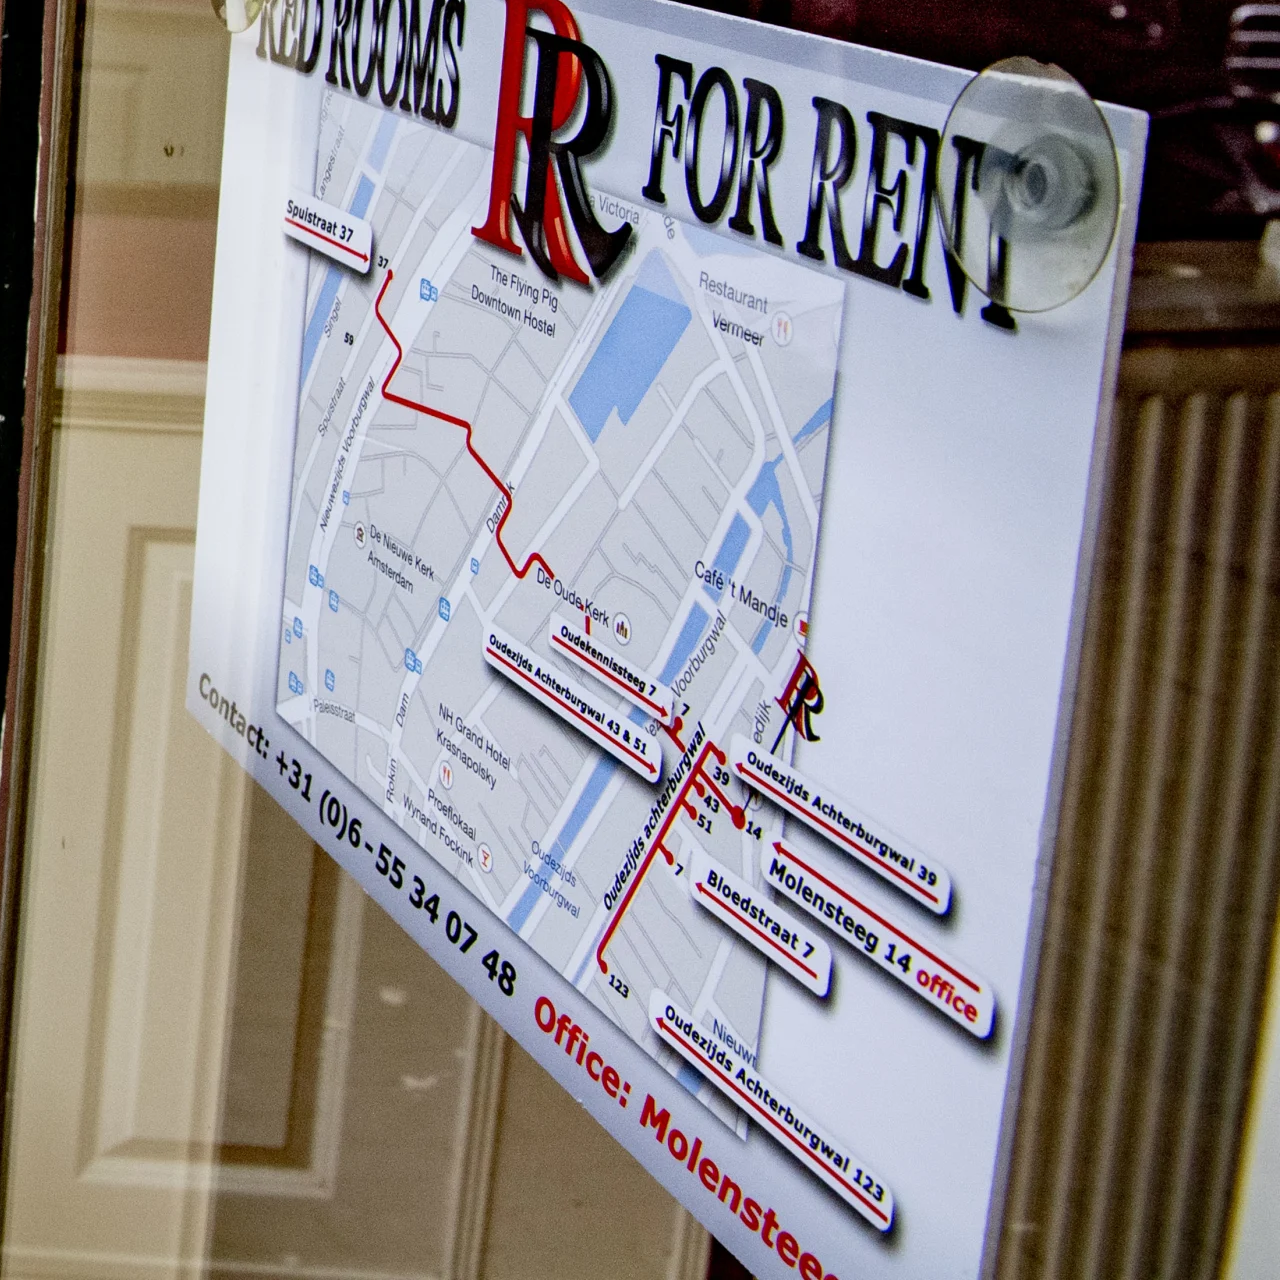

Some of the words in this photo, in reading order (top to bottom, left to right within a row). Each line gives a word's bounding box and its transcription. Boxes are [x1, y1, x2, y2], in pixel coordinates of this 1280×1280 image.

[642, 53, 785, 247] FOR
[287, 198, 337, 236] Spuistraat
[339, 225, 354, 243] 37
[599, 194, 640, 225] Victoria
[377, 255, 389, 269] 37
[490, 264, 508, 286] The
[510, 274, 539, 304] Flying
[542, 288, 559, 313] Pig
[324, 296, 343, 338] Singel
[471, 284, 521, 322] Downtown
[524, 311, 556, 339] Hostel
[699, 271, 768, 314] Restaurant
[344, 332, 354, 346] 59
[712, 309, 765, 347] Vermeer
[318, 376, 347, 438] Spuistraat
[319, 456, 346, 533] Nieuwezijds
[342, 376, 376, 453] Voorburgwal
[485, 480, 516, 534] Damrk
[367, 551, 414, 594] Amsterdam
[369, 524, 382, 542] De
[383, 534, 413, 566] Nieuwe
[415, 557, 435, 581] Kerk
[536, 568, 551, 589] De
[553, 578, 584, 610] Oude
[584, 598, 610, 628] Kerk
[694, 560, 724, 591] Café
[739, 585, 789, 628] Mandje
[560, 625, 647, 695] Oudekennissteeg
[648, 684, 657, 697] 7
[671, 609, 727, 699] Voorburgwal
[313, 698, 356, 723] Paleisstraat
[395, 692, 410, 728] Dam
[489, 633, 533, 673] Oudezijds
[534, 667, 606, 725] Achterburgwal
[606, 719, 621, 737] 43
[622, 728, 631, 745] &
[633, 736, 647, 756] 51
[681, 703, 690, 717] 7
[436, 728, 497, 791] Krasnapolsky
[439, 702, 453, 726] NH
[455, 716, 484, 751] Grand
[485, 739, 511, 771] Hotel
[386, 758, 397, 804] Rokin
[712, 766, 730, 786] 39
[402, 793, 438, 835] Wynand
[438, 826, 474, 868] Fockink
[427, 788, 477, 841] Proeflokaal
[603, 837, 645, 911] Oudezijds
[643, 721, 707, 838] achterburgwal
[696, 814, 713, 835] 51
[703, 795, 720, 813] 43
[745, 820, 763, 841] 14
[747, 751, 810, 801] Oudezijds
[811, 795, 916, 873] Achterburgwal
[917, 864, 938, 887] 39
[523, 859, 581, 920] Voorburgwal
[531, 840, 576, 887] Oudezijds
[674, 863, 684, 877] 7
[706, 869, 800, 951] Bloedstraat
[804, 941, 816, 960] 7
[769, 858, 880, 953] Molensteeg
[884, 944, 912, 974] 14
[916, 969, 979, 1024] office
[199, 673, 270, 760] Contact:
[275, 750, 312, 803] +31
[408, 875, 441, 925] 34
[445, 910, 479, 954] 07
[481, 949, 517, 998] 48
[534, 996, 632, 1109] Office:
[639, 1093, 839, 1280] Molenstee
[608, 974, 630, 999] 123
[665, 1005, 733, 1072] Oudezijds
[735, 1067, 850, 1173] Achterburgwal
[852, 1168, 886, 1203] 123
